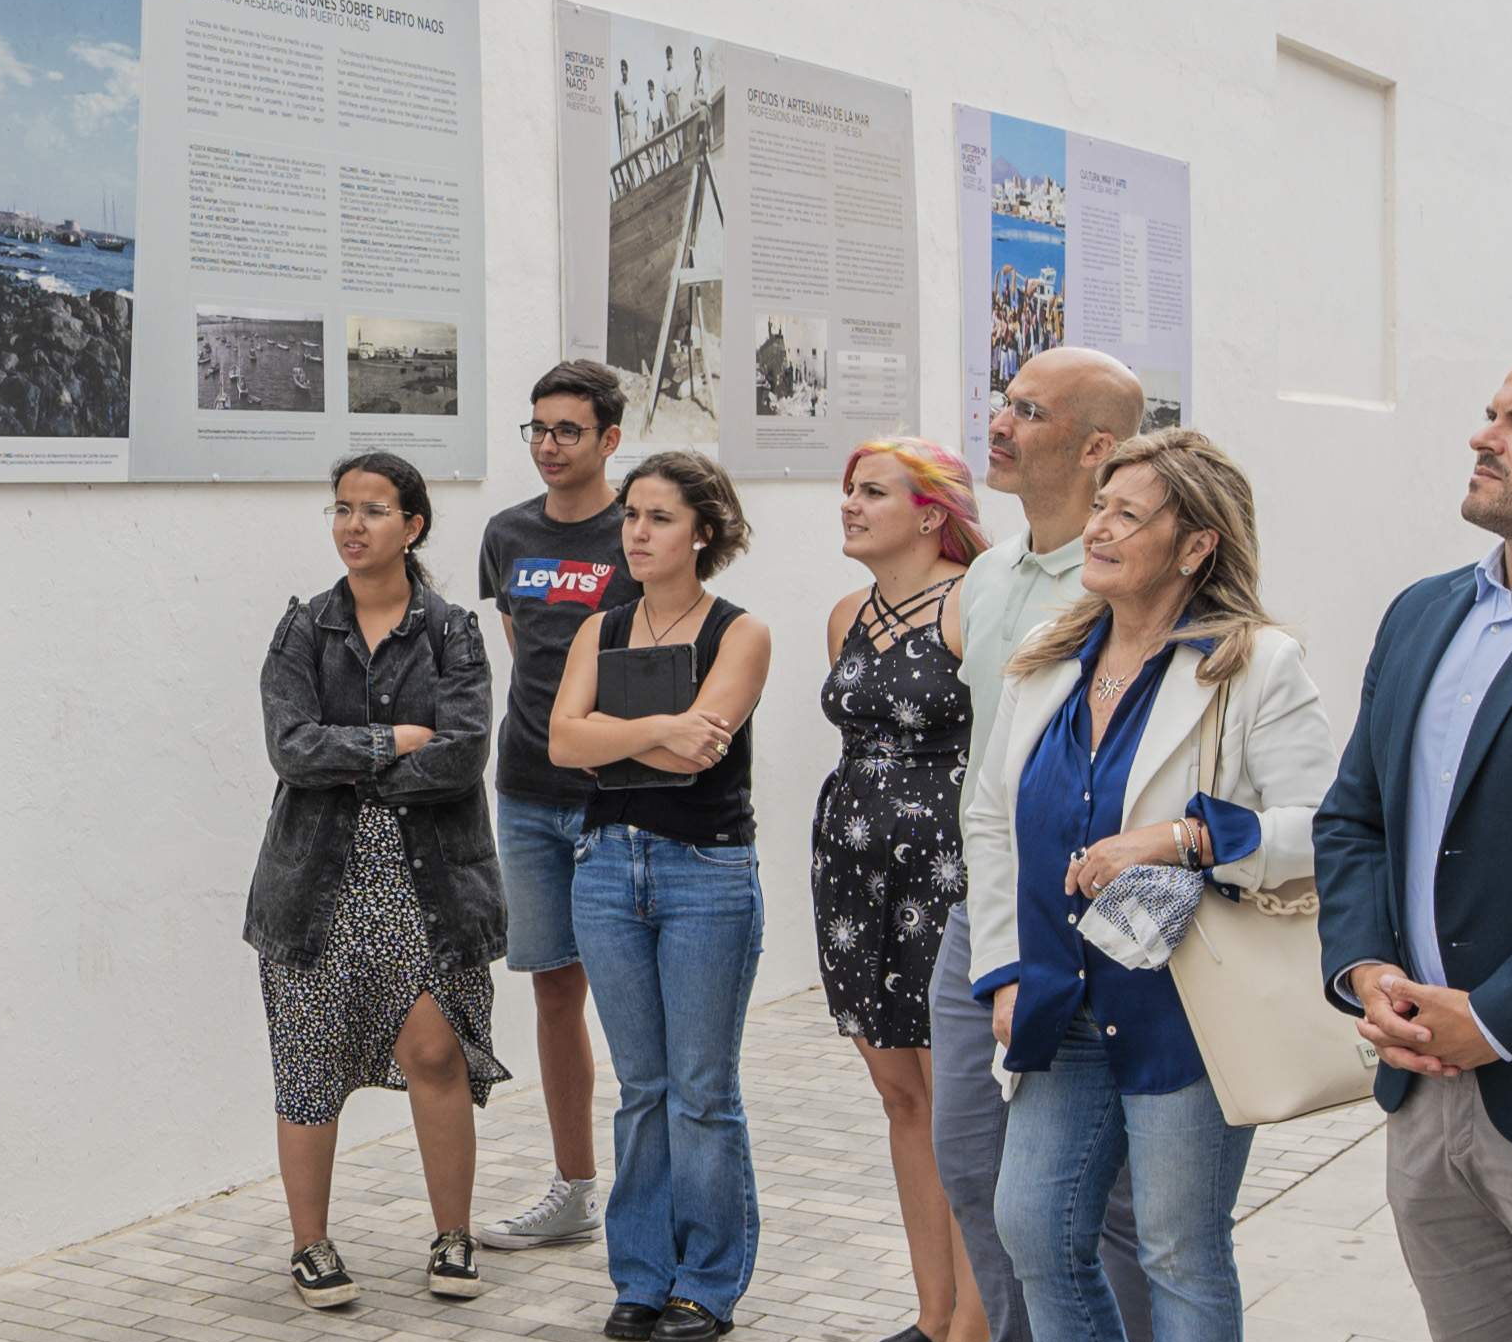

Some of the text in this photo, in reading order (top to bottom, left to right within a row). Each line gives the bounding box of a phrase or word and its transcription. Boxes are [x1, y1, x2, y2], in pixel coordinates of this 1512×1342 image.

[294, 3, 308, 20] ON
[310, 7, 344, 27] PUERTO
[346, 16, 370, 32] NAOS
[376, 5, 415, 28] PUERTO
[417, 15, 444, 35] NAOS
